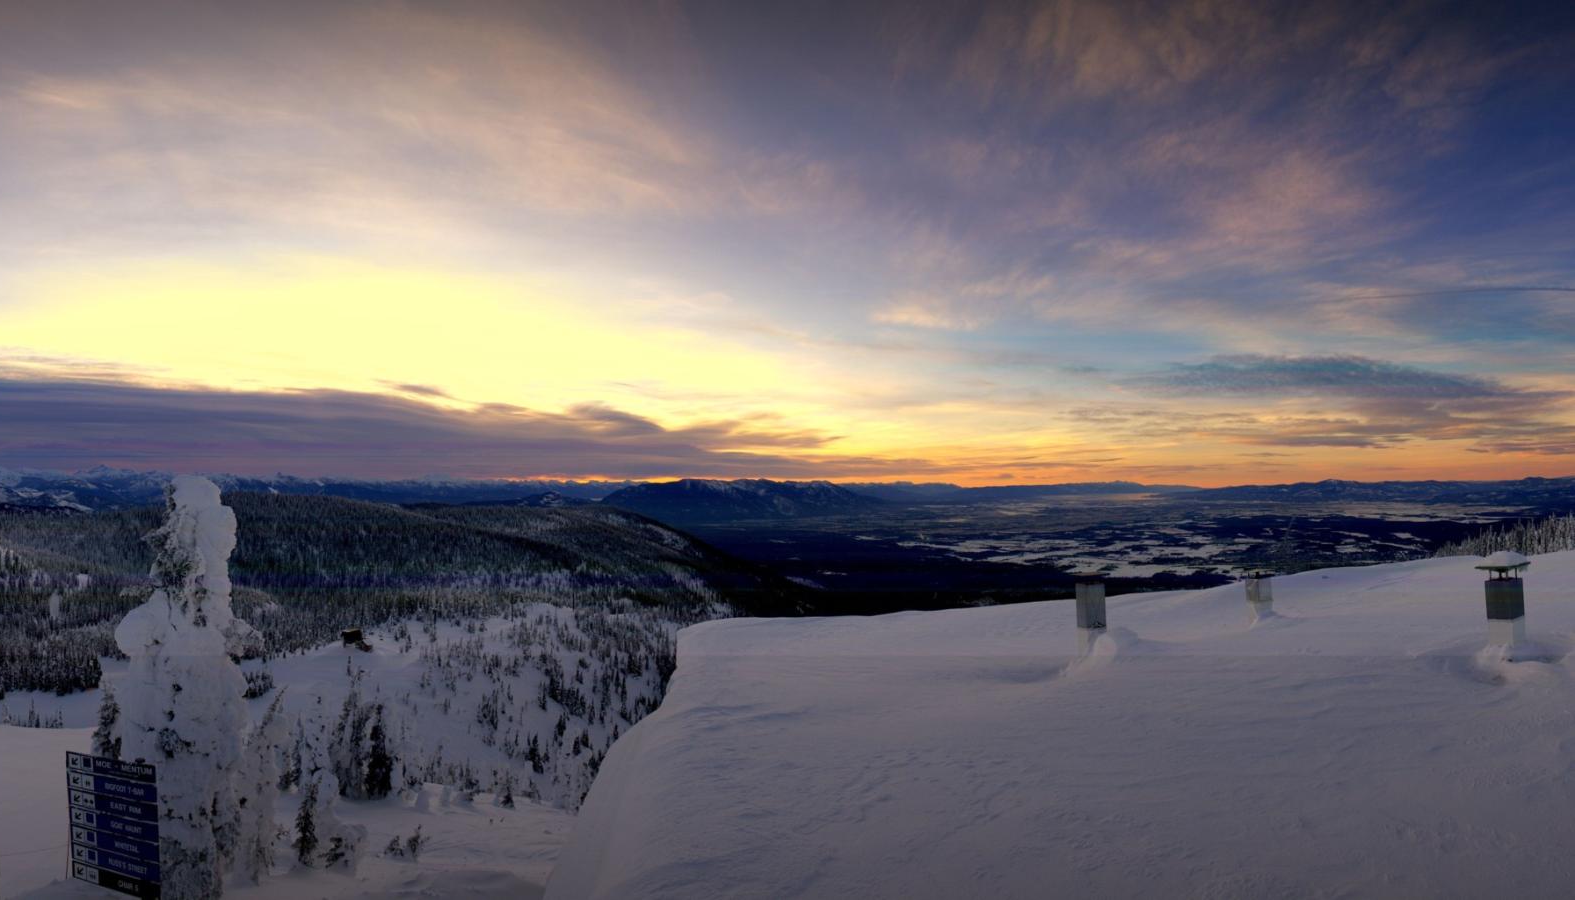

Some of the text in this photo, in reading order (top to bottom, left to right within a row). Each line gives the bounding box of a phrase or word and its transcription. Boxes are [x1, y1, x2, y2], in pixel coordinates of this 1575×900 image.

[95, 760, 112, 769] MOE
[121, 764, 153, 775] MENTUM
[110, 801, 126, 811] EAST
